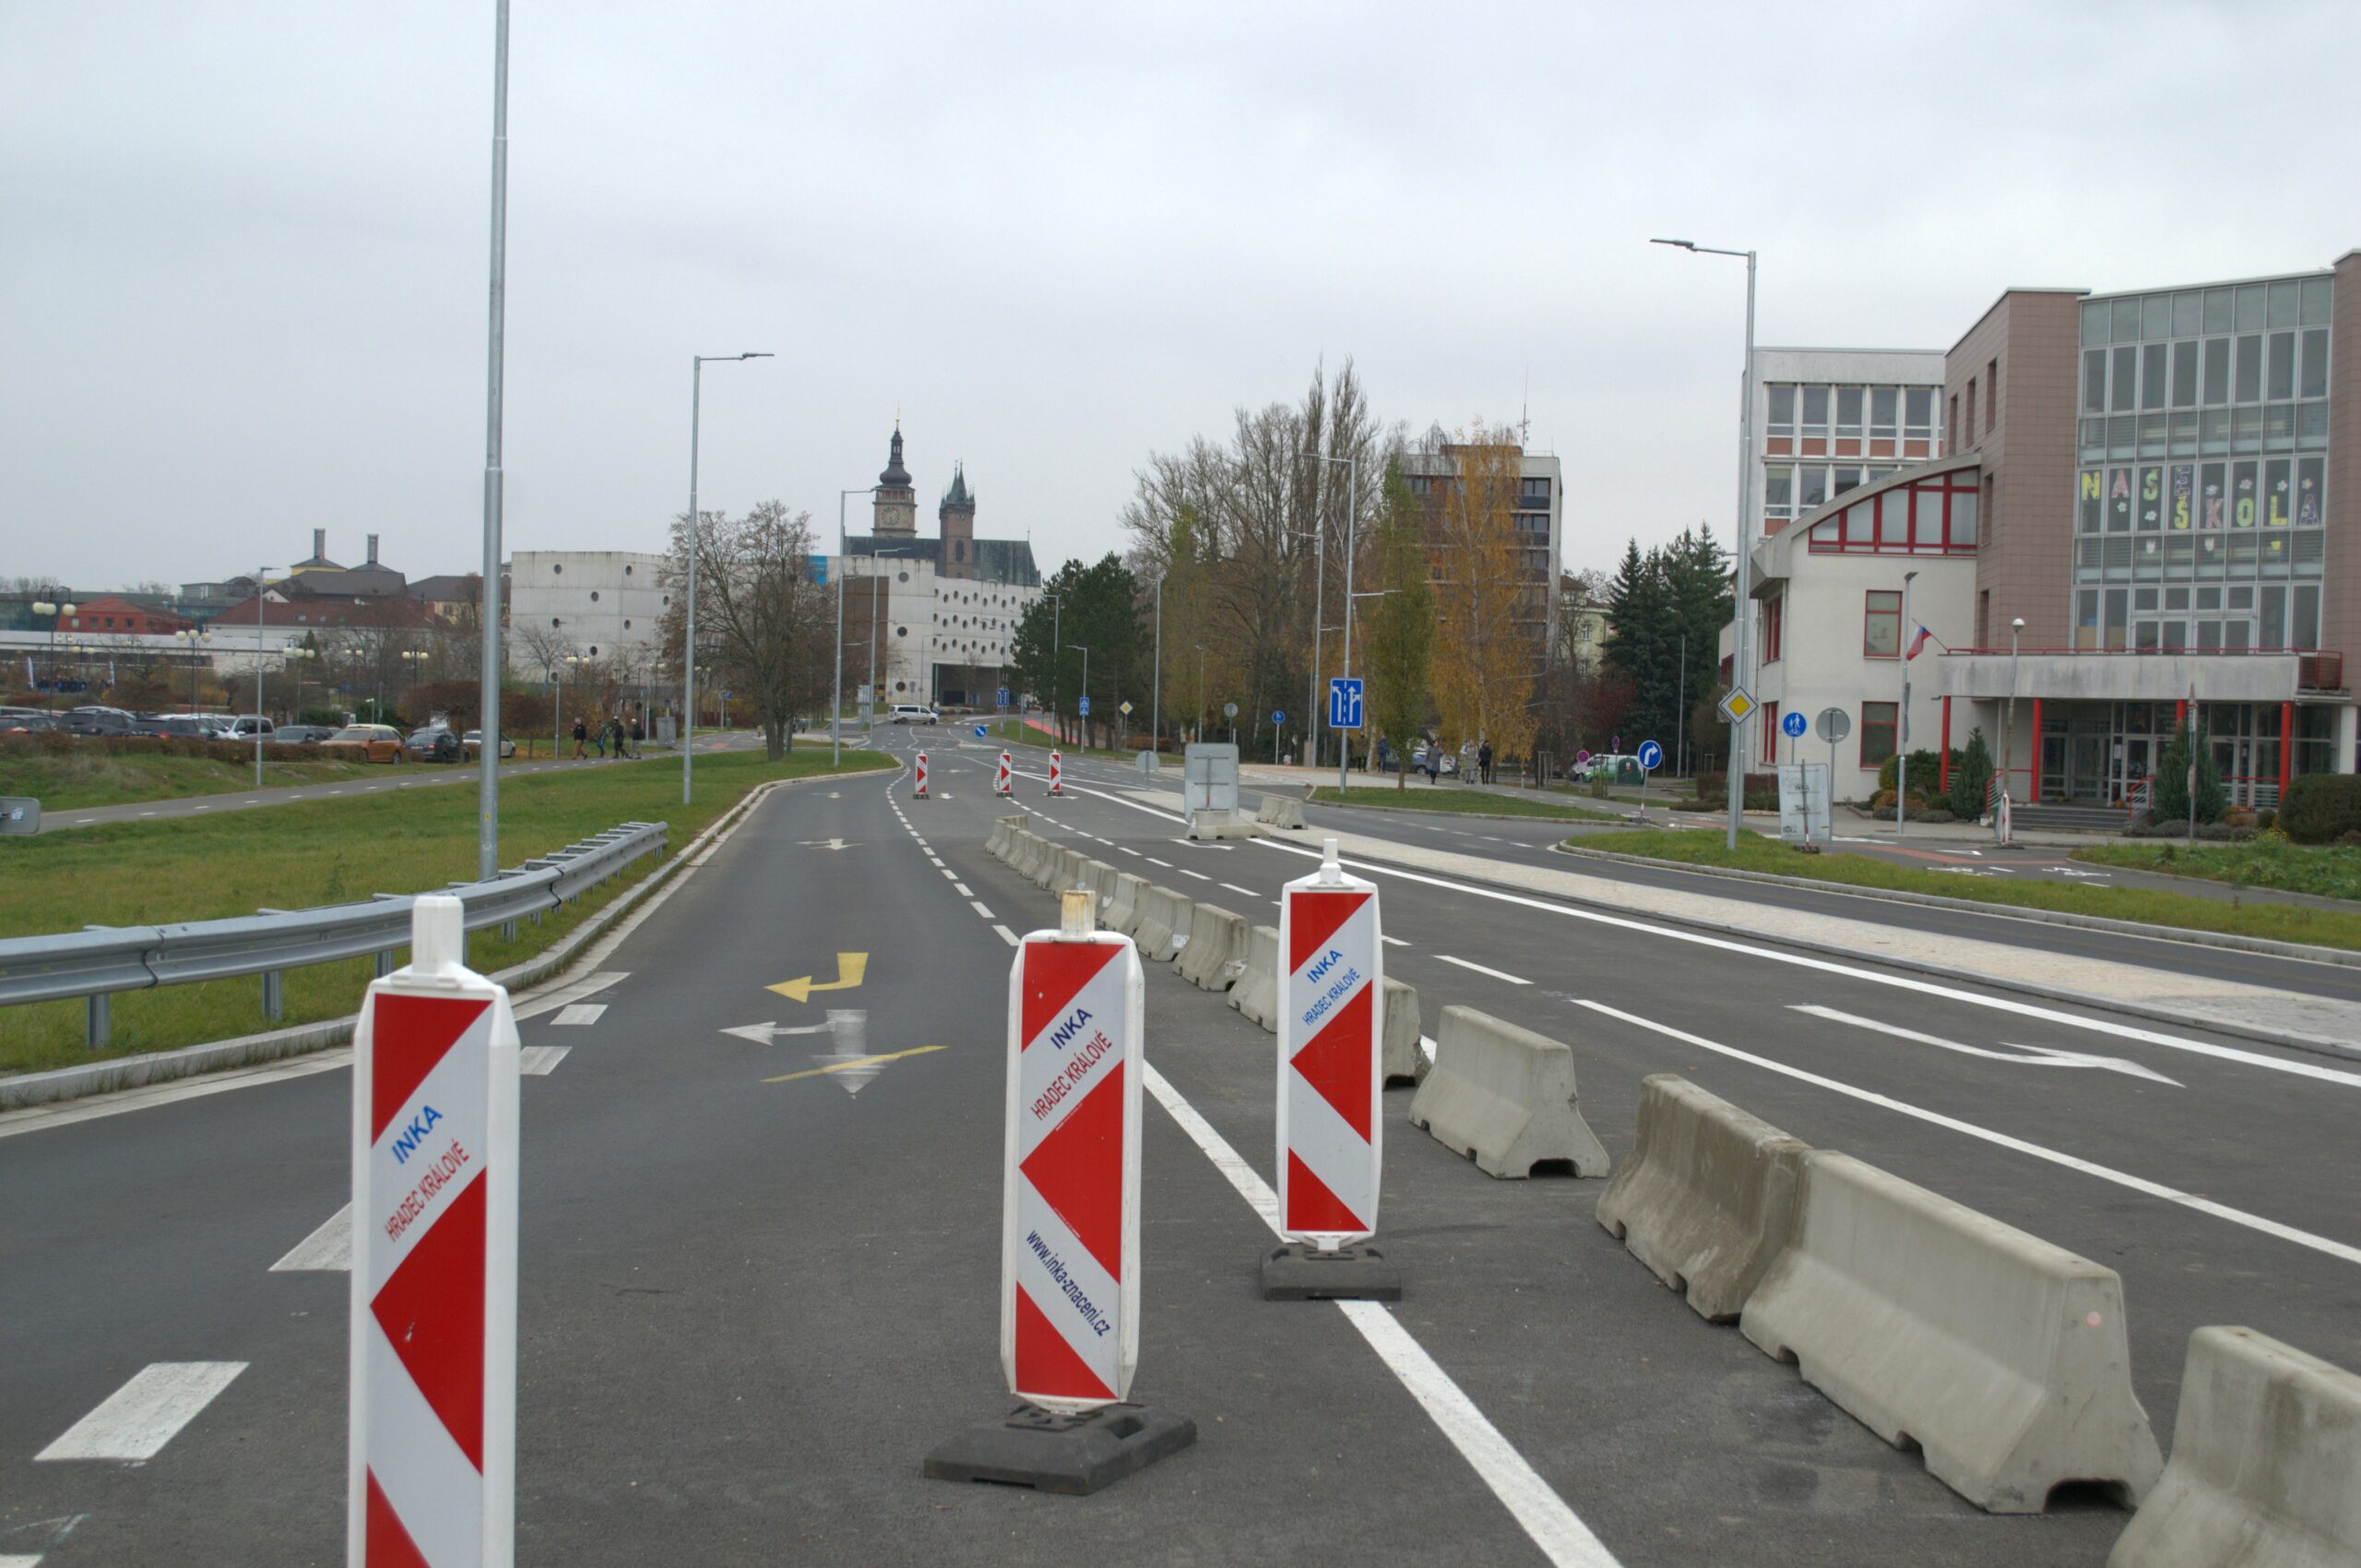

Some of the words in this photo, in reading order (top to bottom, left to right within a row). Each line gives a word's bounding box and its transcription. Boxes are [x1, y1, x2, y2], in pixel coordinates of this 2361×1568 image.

[2081, 464, 2190, 501] NAŠE
[2174, 493, 2320, 529] ŠKOLA
[1307, 950, 1343, 983] INKA
[1050, 1008, 1093, 1050] INKA
[1301, 996, 1332, 1026] HRADEC
[1030, 1075, 1072, 1121] HRADEC
[1064, 1029, 1112, 1084] KRÁLOVÉ
[391, 1105, 444, 1165] INKA
[385, 1190, 425, 1242] HRADEC
[418, 1137, 469, 1202] KRÁLOVÉ
[1026, 1229, 1111, 1336] www.inka-znaceni.cz
